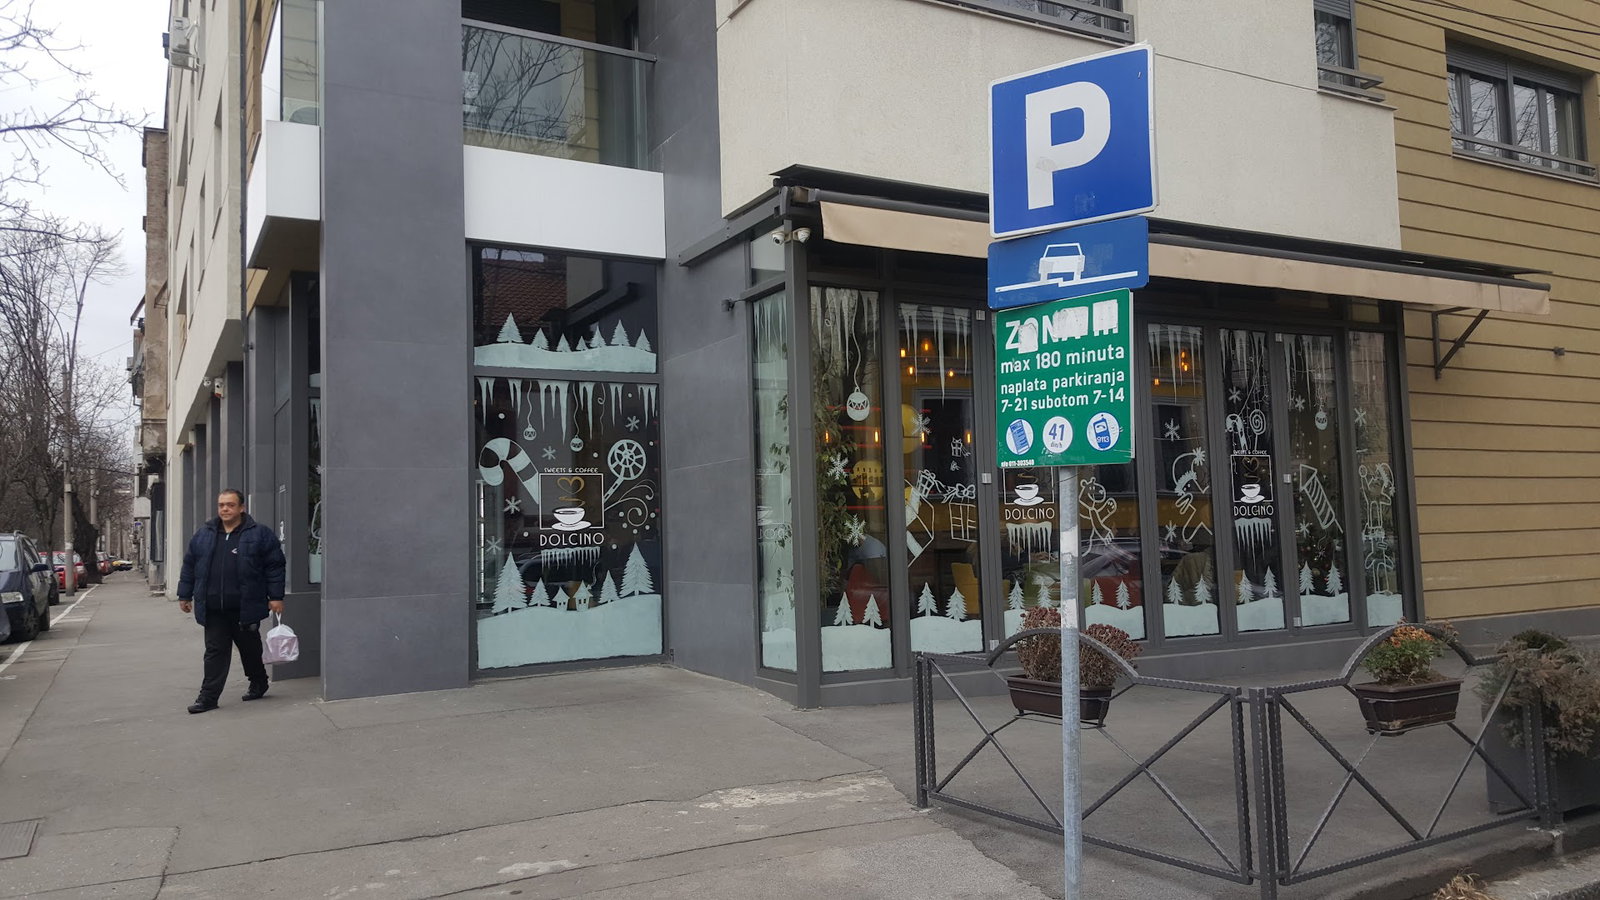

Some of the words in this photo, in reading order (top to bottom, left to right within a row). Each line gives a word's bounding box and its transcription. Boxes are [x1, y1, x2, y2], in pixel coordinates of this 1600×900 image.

[1025, 81, 1111, 210] P
[1001, 358, 1030, 374] max
[1035, 350, 1061, 370] 180
[1066, 344, 1125, 366] minuta
[1001, 378, 1047, 397] naplata
[1052, 368, 1125, 392] parkiranja
[1001, 397, 1028, 413] 7-21
[1031, 393, 1089, 411] subotom
[1093, 387, 1125, 405] 7-14
[1048, 423, 1065, 441] 41
[1004, 507, 1055, 521] DOLCINO
[1233, 505, 1274, 516] DOLCINO
[539, 532, 605, 547] DOLCINO
